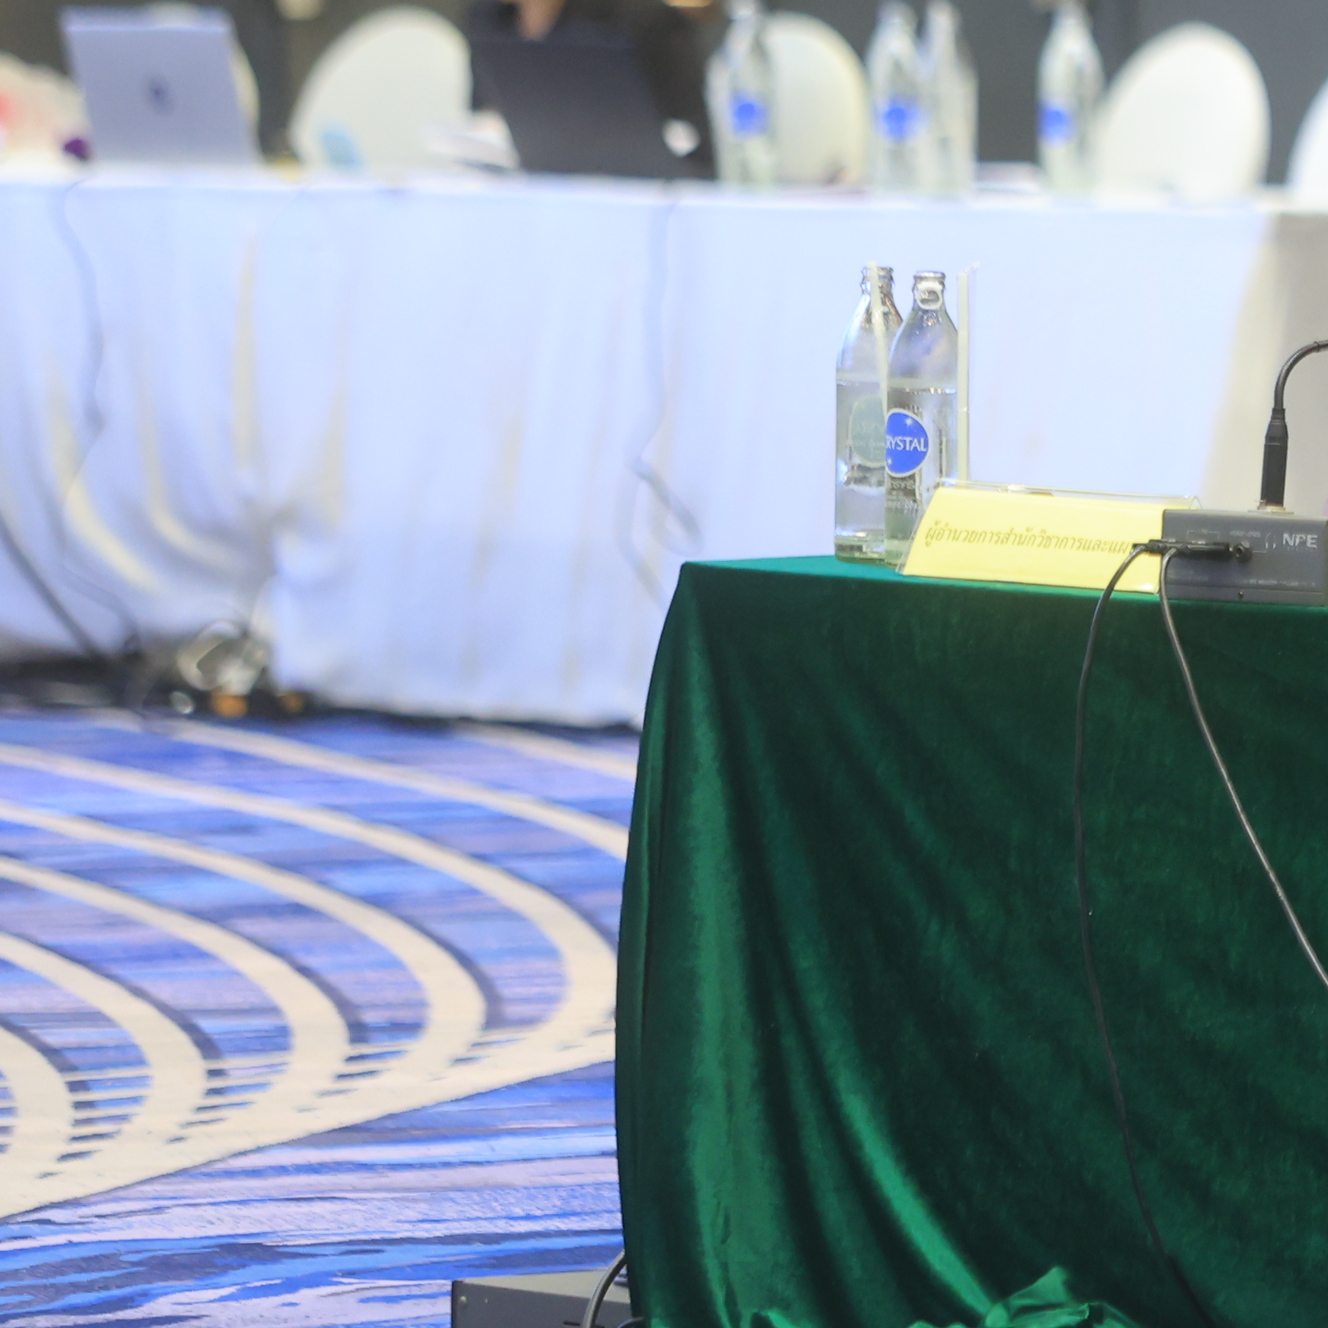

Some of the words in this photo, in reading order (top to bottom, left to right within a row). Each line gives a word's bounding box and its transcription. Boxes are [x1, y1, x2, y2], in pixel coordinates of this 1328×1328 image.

[886, 435, 927, 452] RYSTAL
[924, 520, 1136, 555] ผู้อำนวยการสำนักวิชาการและแผ
[1282, 533, 1318, 548] NPE
